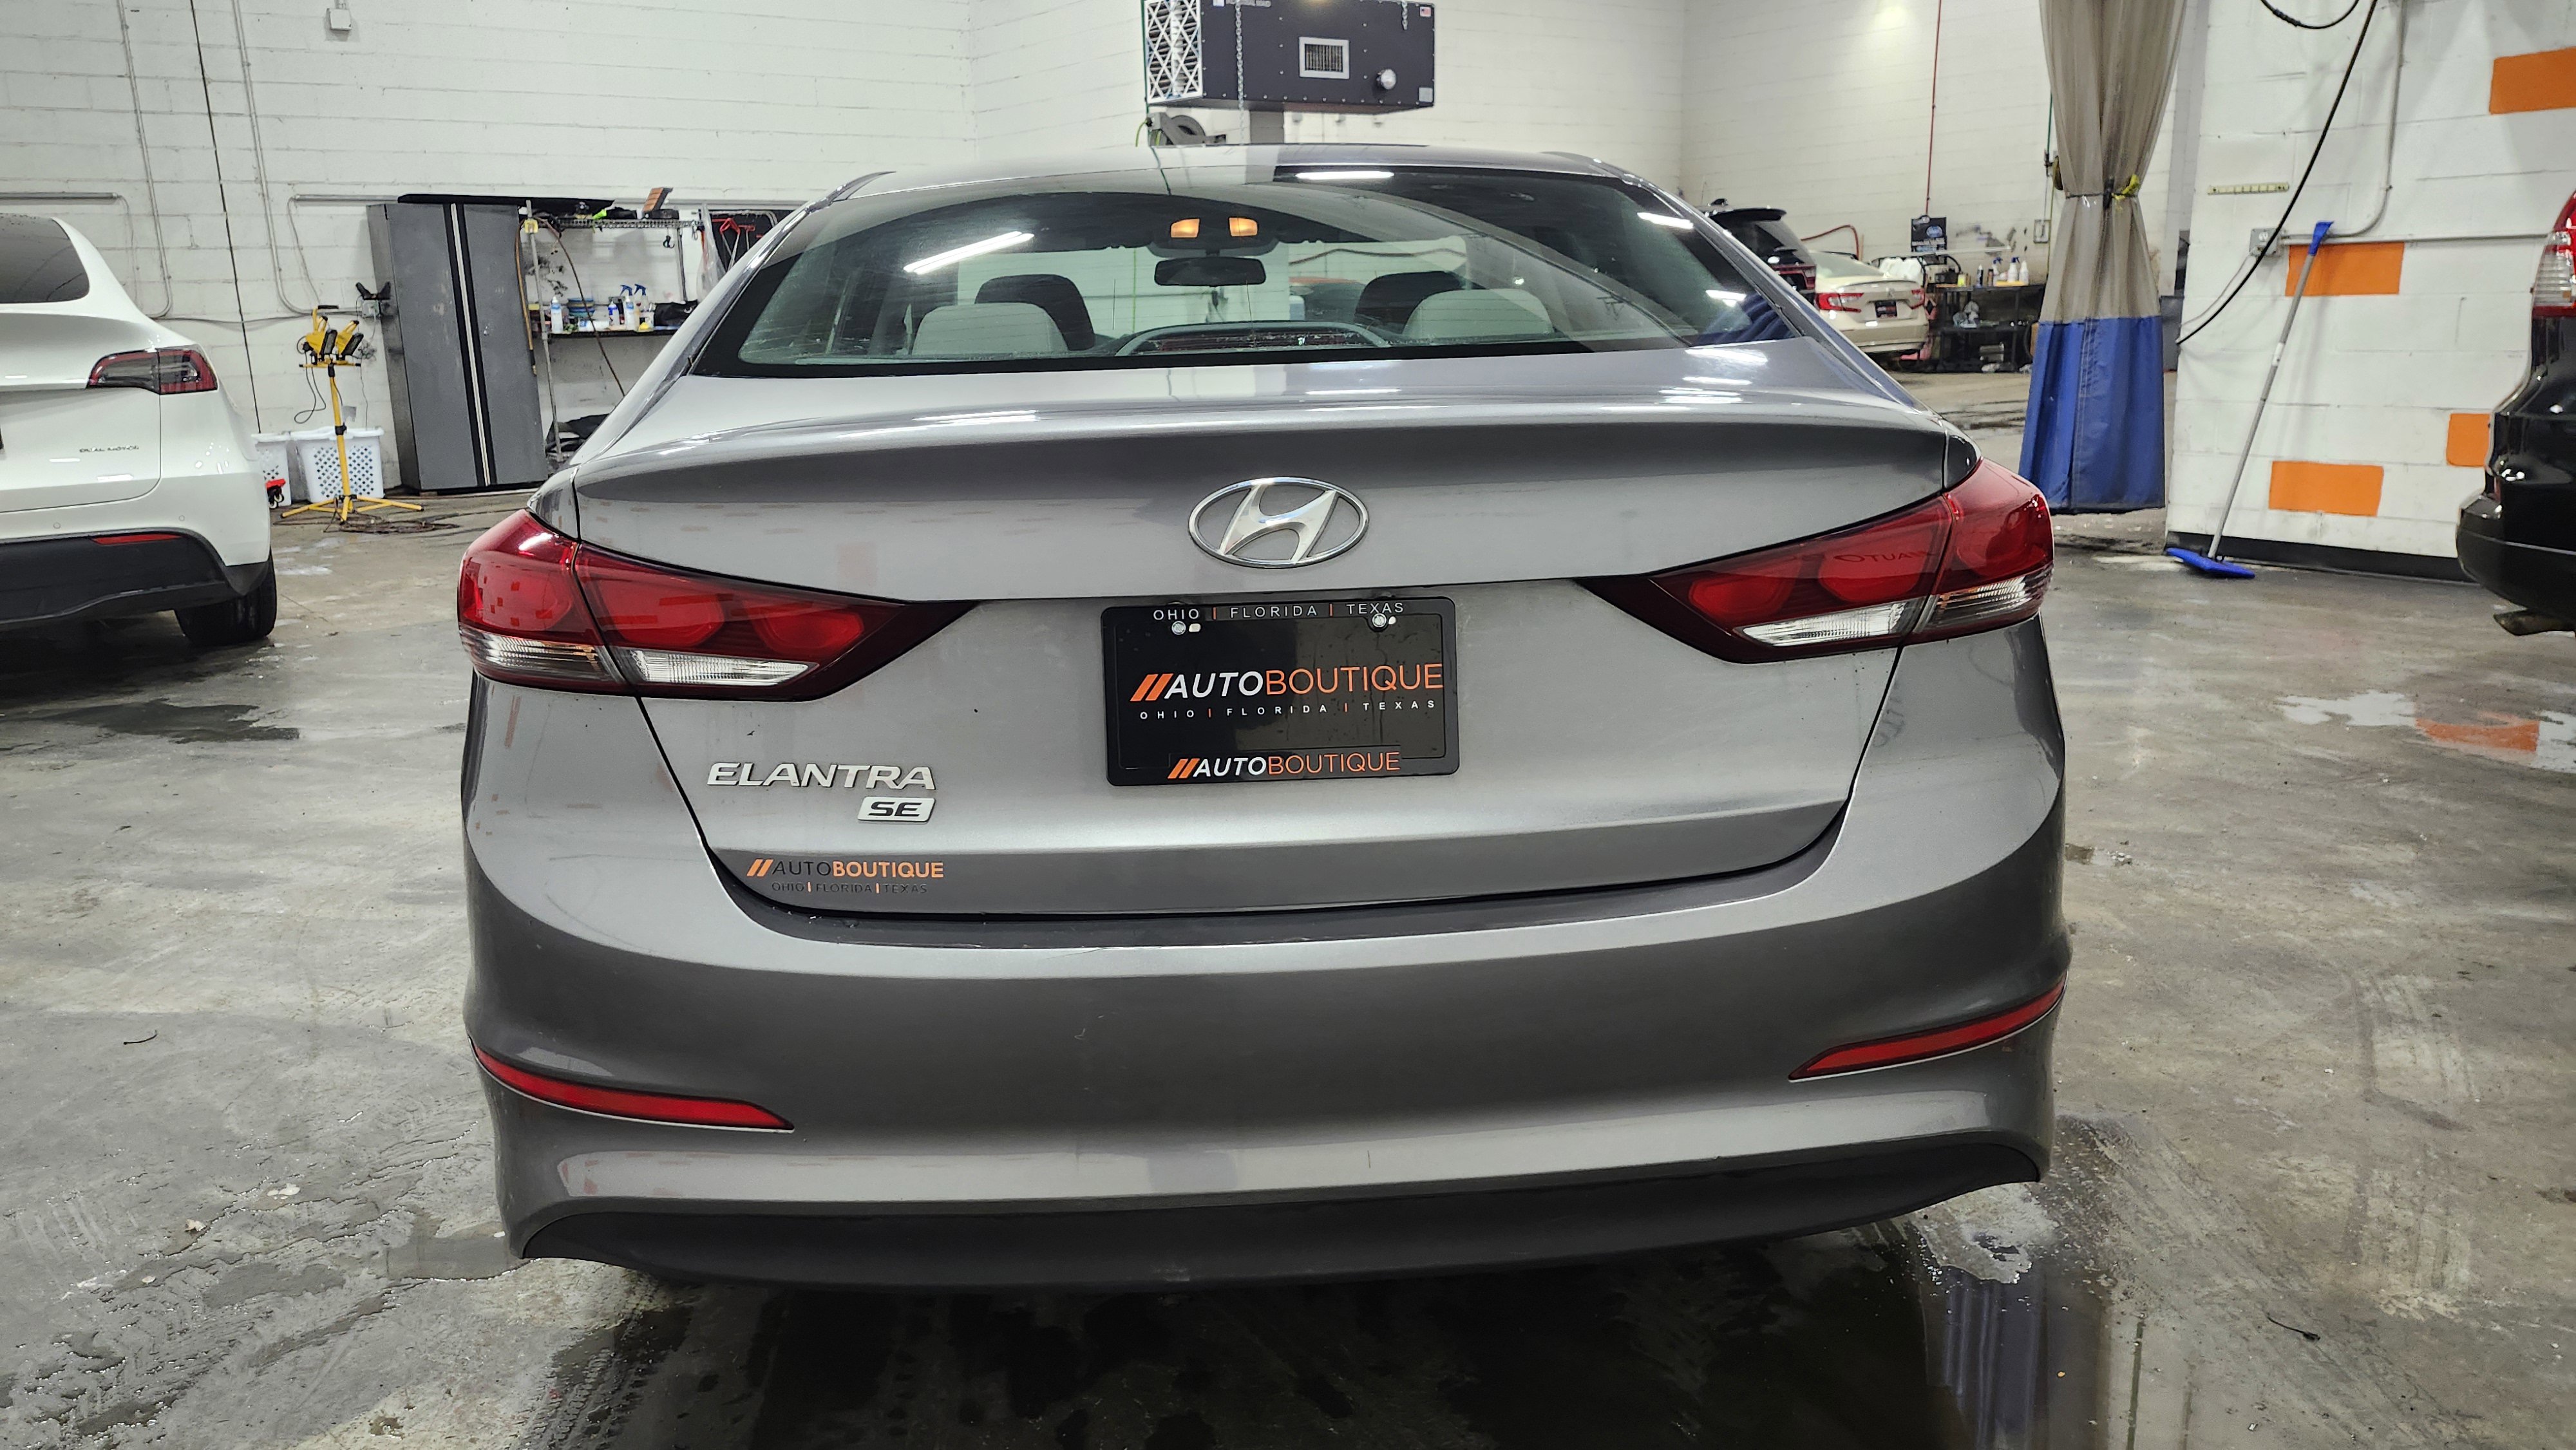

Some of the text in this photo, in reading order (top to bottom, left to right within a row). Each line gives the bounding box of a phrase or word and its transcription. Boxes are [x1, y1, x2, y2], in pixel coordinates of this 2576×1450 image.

[1153, 602, 1404, 621] OHIO FLORIDA TEXAS
[1164, 663, 1444, 700] AUTOBOUTIQUE
[1140, 699, 1435, 720] OHIO FLORIDA TEXAS
[1193, 751, 1401, 778] AUTOBOUTIQUE
[707, 762, 936, 790] ELANTRA
[867, 801, 923, 817] SE
[772, 860, 944, 878] AUTOBOUTIQUE
[772, 882, 927, 894] OHIO FLORIDA TEXAS
